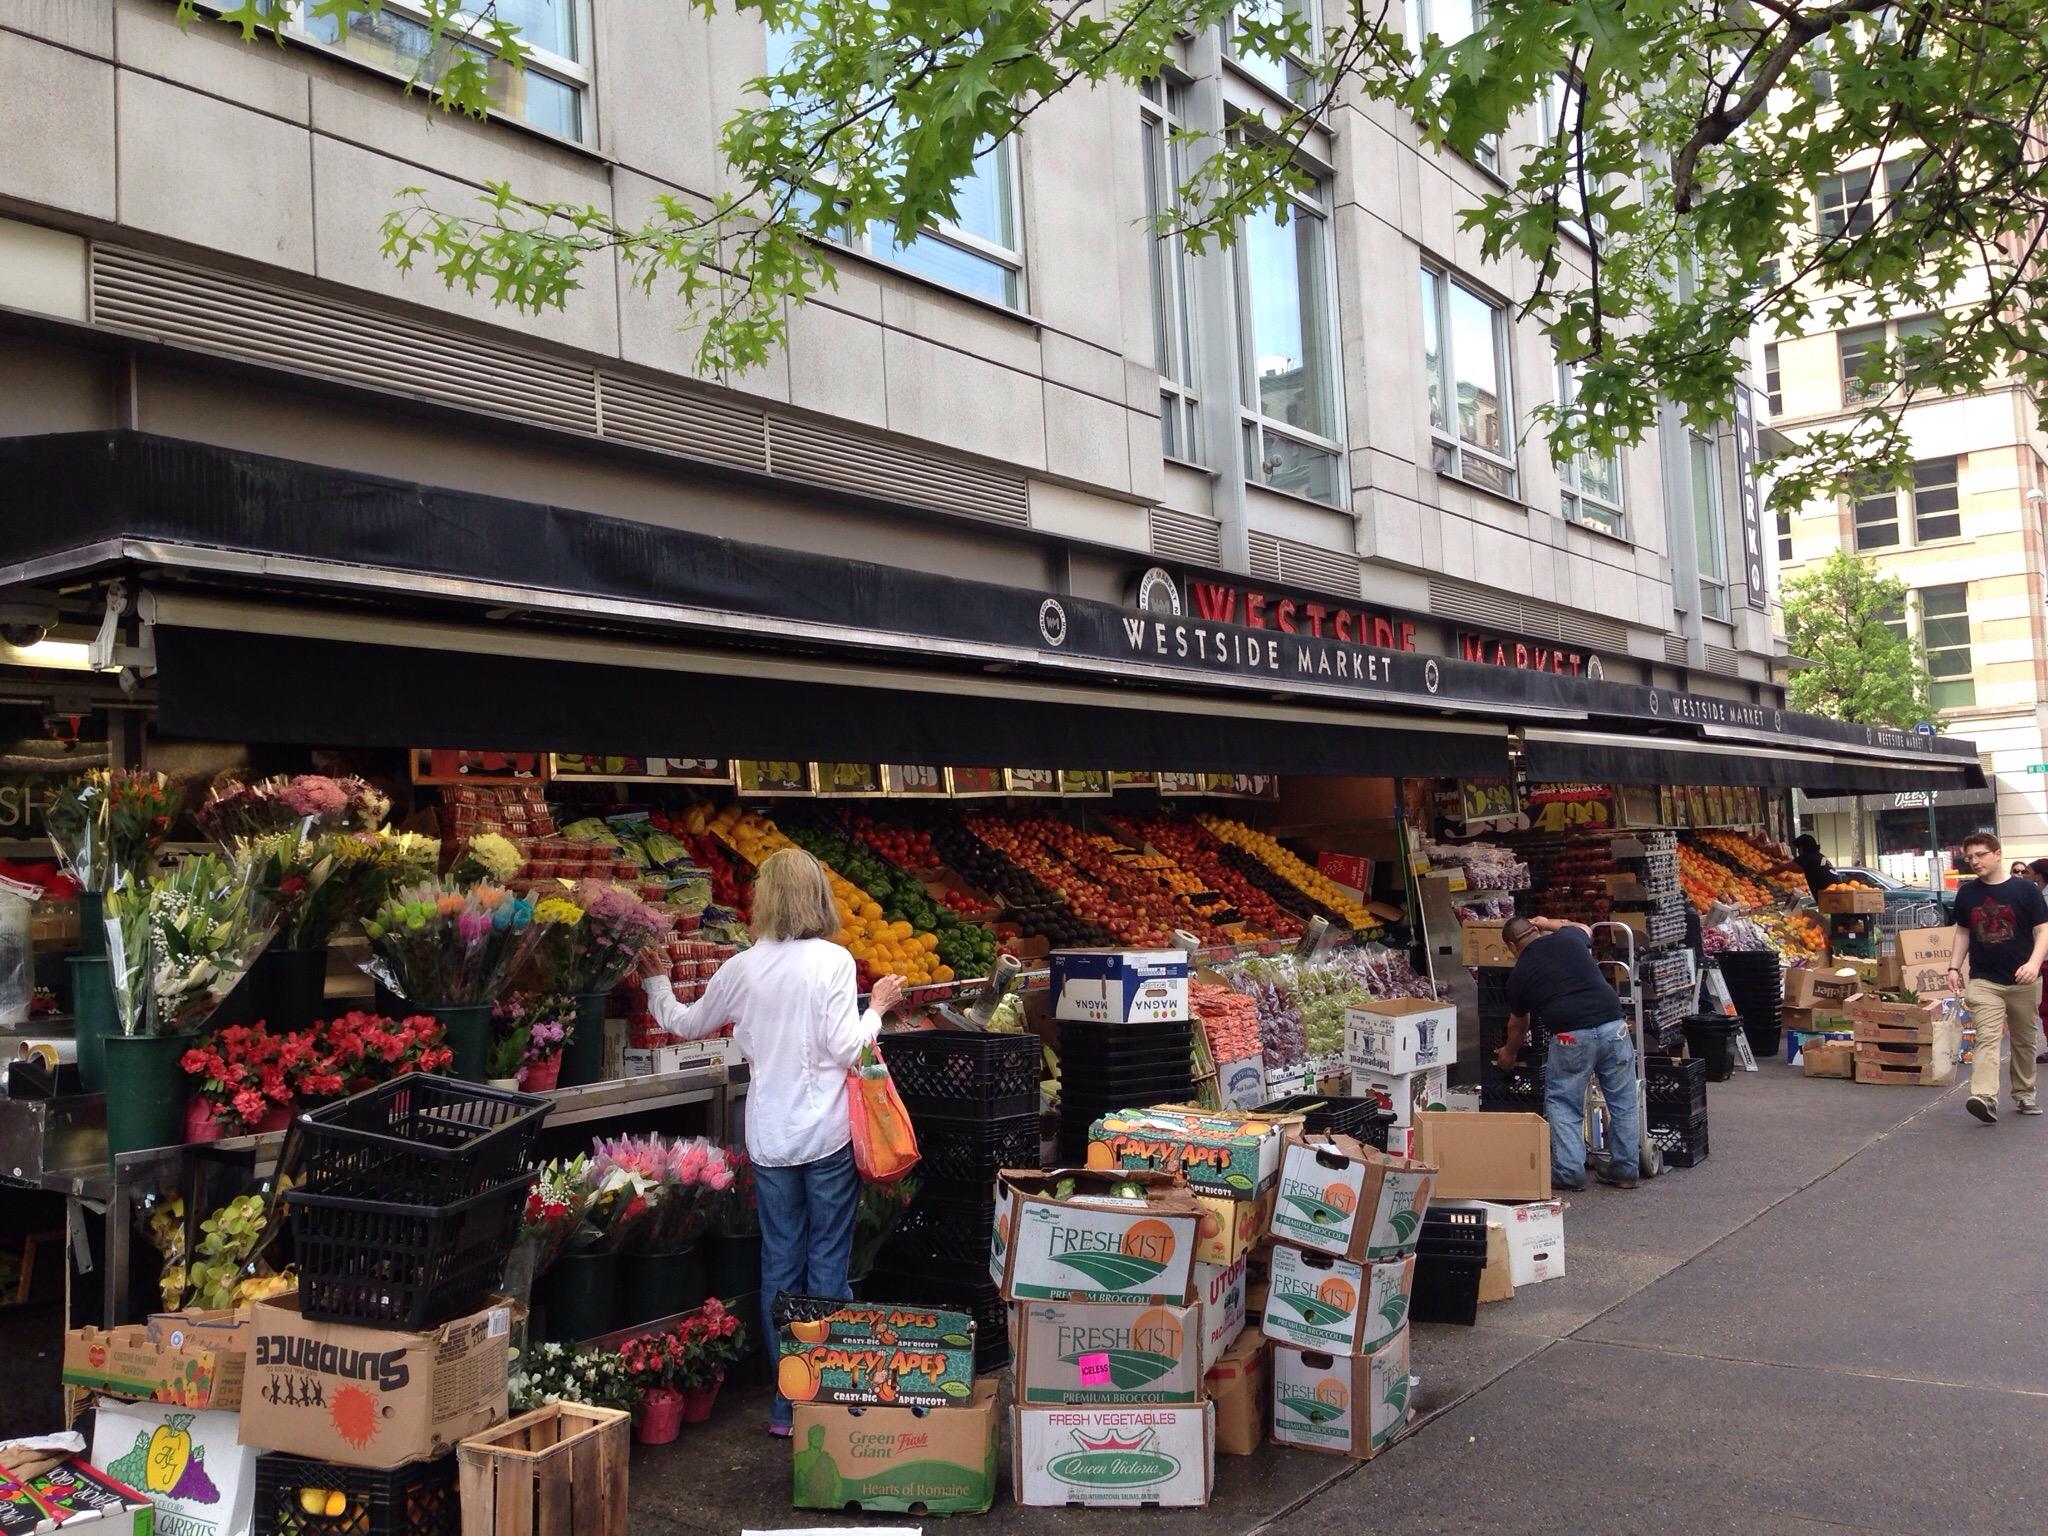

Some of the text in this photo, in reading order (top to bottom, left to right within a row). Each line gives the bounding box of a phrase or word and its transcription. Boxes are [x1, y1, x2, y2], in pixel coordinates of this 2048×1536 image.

[1740, 426, 1759, 556] PARK
[1194, 583, 1416, 653] WESTSIDE
[1122, 617, 1279, 669] WESTSIDE
[1298, 645, 1391, 682] MARKET
[1672, 698, 1764, 726] WESTSIDE MARKET
[1075, 1000, 1108, 1010] MAGNA
[1135, 1000, 1178, 1010] MAGNA
[1114, 1135, 1231, 1169] CRAZY APES
[1279, 1216, 1311, 1233] PREMIUM
[1311, 1223, 1345, 1241] BROCCOLI
[888, 1312, 937, 1328] APES
[1277, 1318, 1306, 1334] PREMIUM
[1307, 1325, 1342, 1341] BROCCOLI
[810, 1346, 948, 1376] CRAZY APES
[833, 1391, 947, 1406] CRAZY-BIG APE'RICOTS
[1063, 1392, 1165, 1404] PREMIUM BROCCOLI
[1049, 1413, 1176, 1426] FRESH VEGETABLES
[849, 1431, 928, 1451] Green Fresh
[851, 1444, 892, 1458] Giant
[1065, 1458, 1160, 1476] Queen Victoria
[863, 1482, 970, 1497] Hearts of Romaine
[160, 1514, 217, 1536] CARROTS
